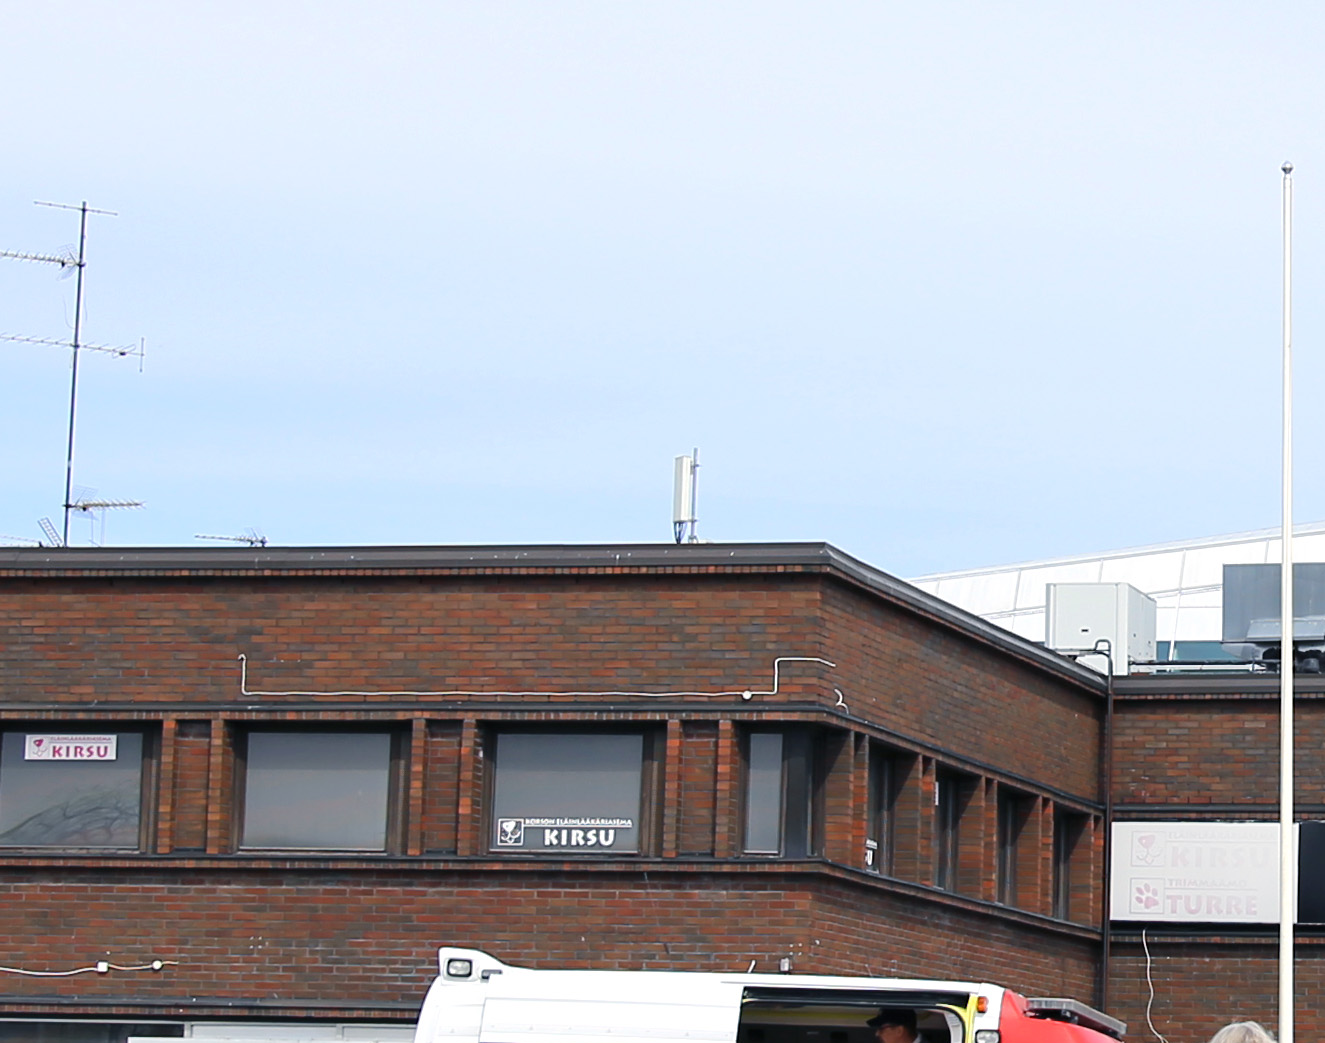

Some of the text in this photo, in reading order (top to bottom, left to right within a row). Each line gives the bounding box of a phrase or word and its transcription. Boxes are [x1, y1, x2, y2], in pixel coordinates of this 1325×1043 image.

[52, 746, 108, 758] KIRSU
[544, 829, 615, 846] KIRSU
[1170, 846, 1270, 868] KIRSU
[1168, 878, 1247, 888] TRIMMAAMO
[1165, 894, 1258, 916] TURRE
